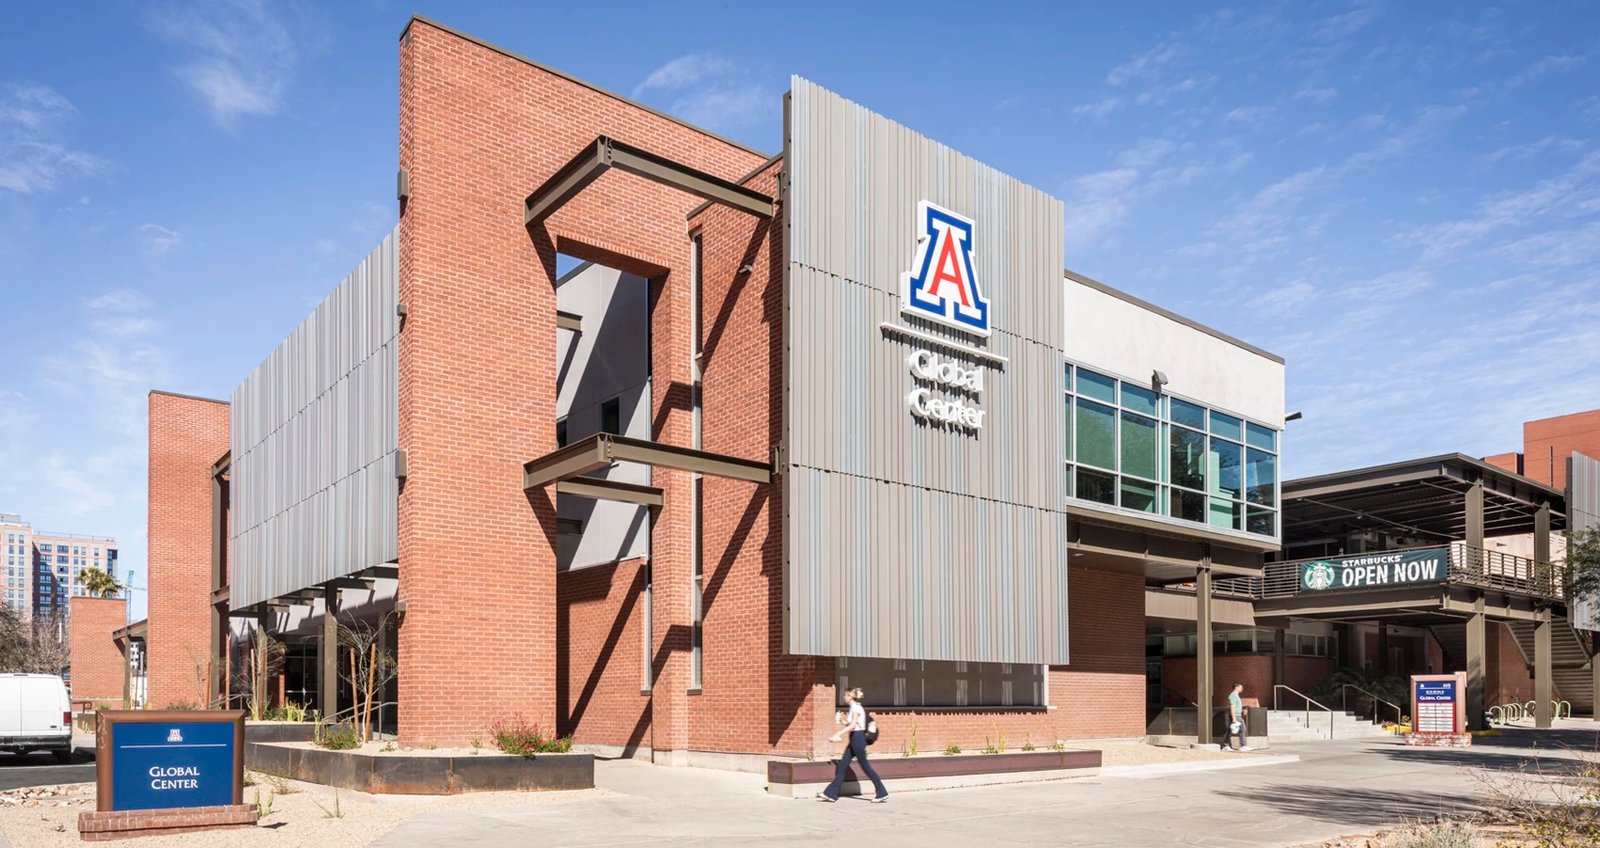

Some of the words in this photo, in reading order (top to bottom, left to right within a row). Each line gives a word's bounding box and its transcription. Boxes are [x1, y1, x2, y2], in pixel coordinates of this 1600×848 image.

[901, 200, 991, 338] A
[909, 349, 984, 392] Global
[908, 387, 985, 429] Center
[1342, 555, 1402, 568] STARBUCKS
[1342, 564, 1389, 587] OPEN
[1394, 559, 1438, 583] NOW
[149, 766, 200, 777] GLOBAL
[151, 779, 199, 790] CENTER
